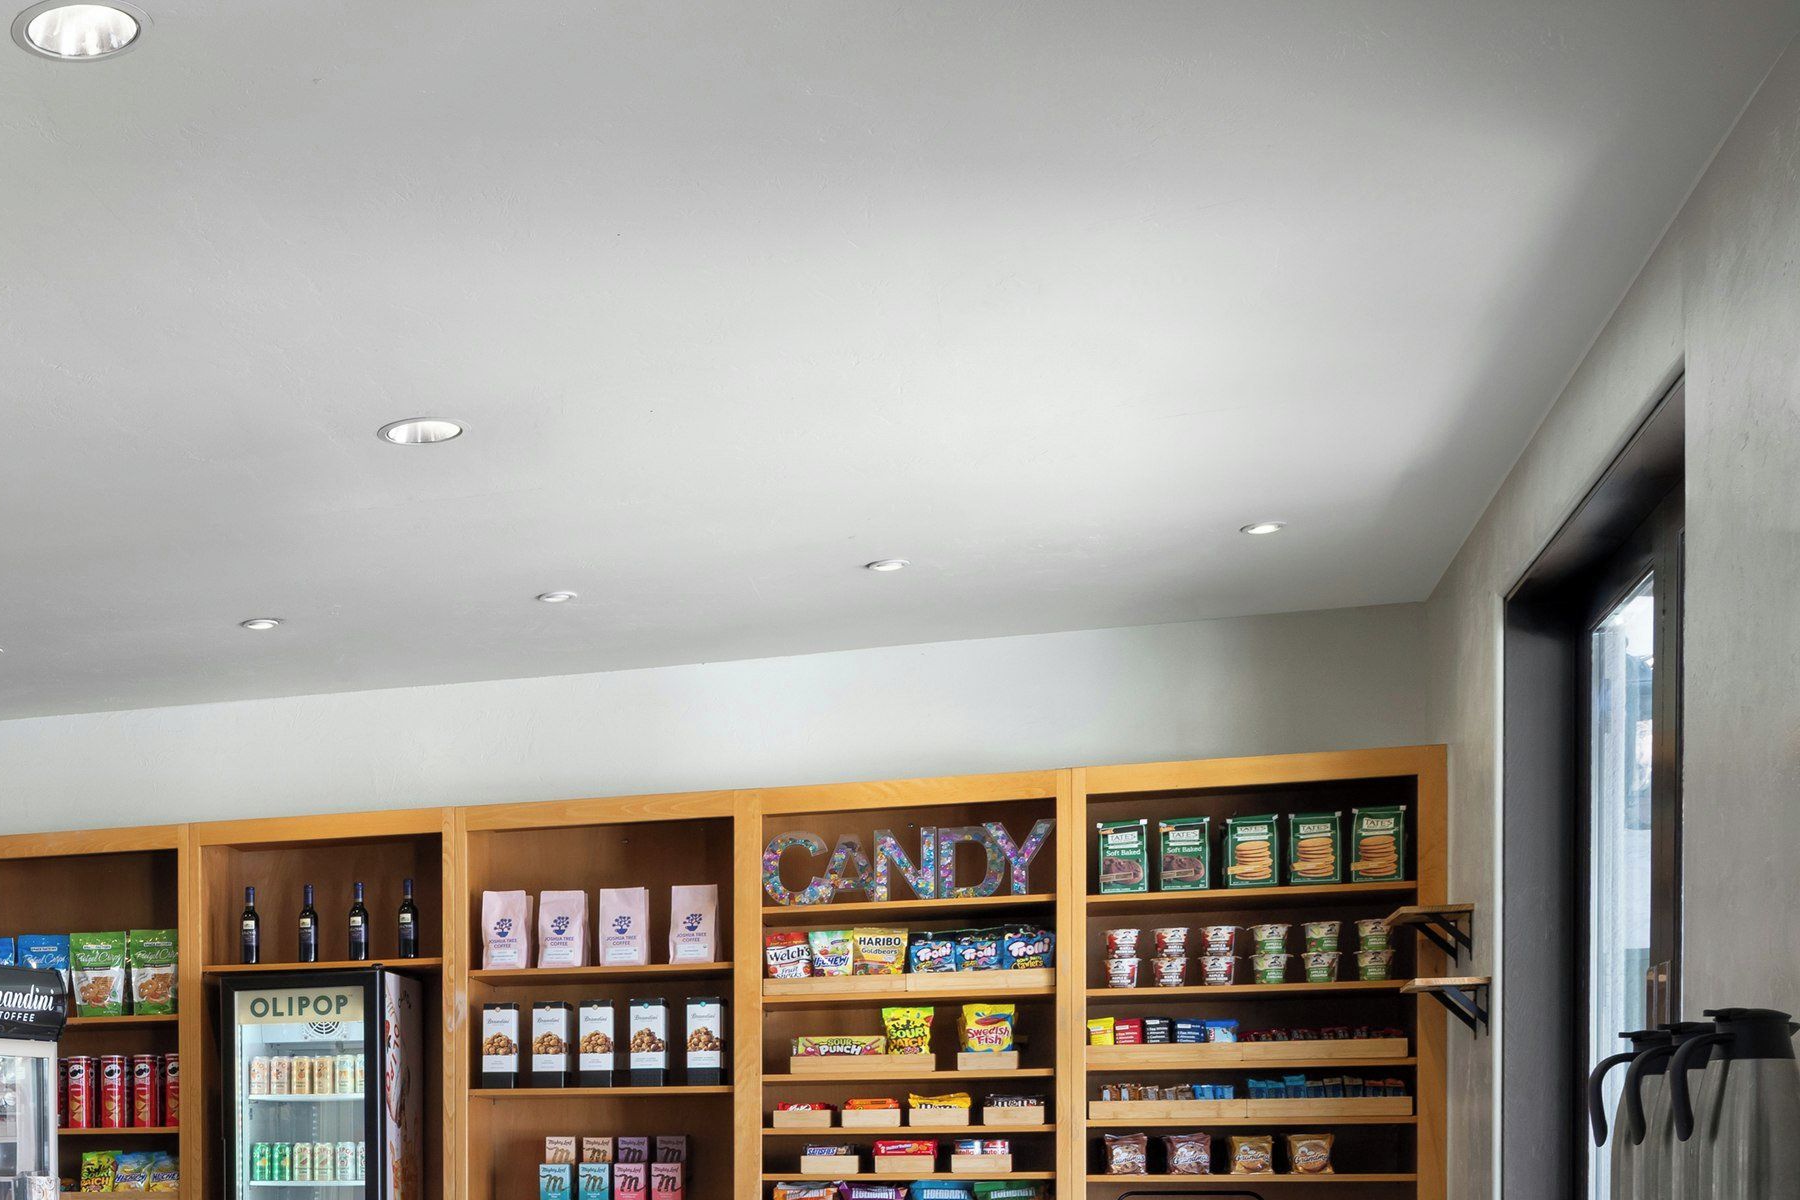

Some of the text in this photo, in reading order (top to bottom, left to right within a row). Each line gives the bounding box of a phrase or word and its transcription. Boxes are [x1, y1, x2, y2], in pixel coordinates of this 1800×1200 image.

[1121, 849, 1141, 857] Baked
[762, 818, 1056, 906] CANDY
[859, 937, 901, 946] HARIBO
[1008, 938, 1049, 957] Trolli
[770, 946, 811, 962] Welch's
[917, 943, 951, 961] Trolli
[962, 943, 996, 961] Trolli
[250, 994, 349, 1018] OLIPOP
[0, 1010, 36, 1023] TOFFEE
[890, 1027, 925, 1039] SOUR
[967, 1025, 1010, 1039] Swedish
[977, 1034, 1002, 1046] Fish
[820, 1045, 862, 1056] PUNCH
